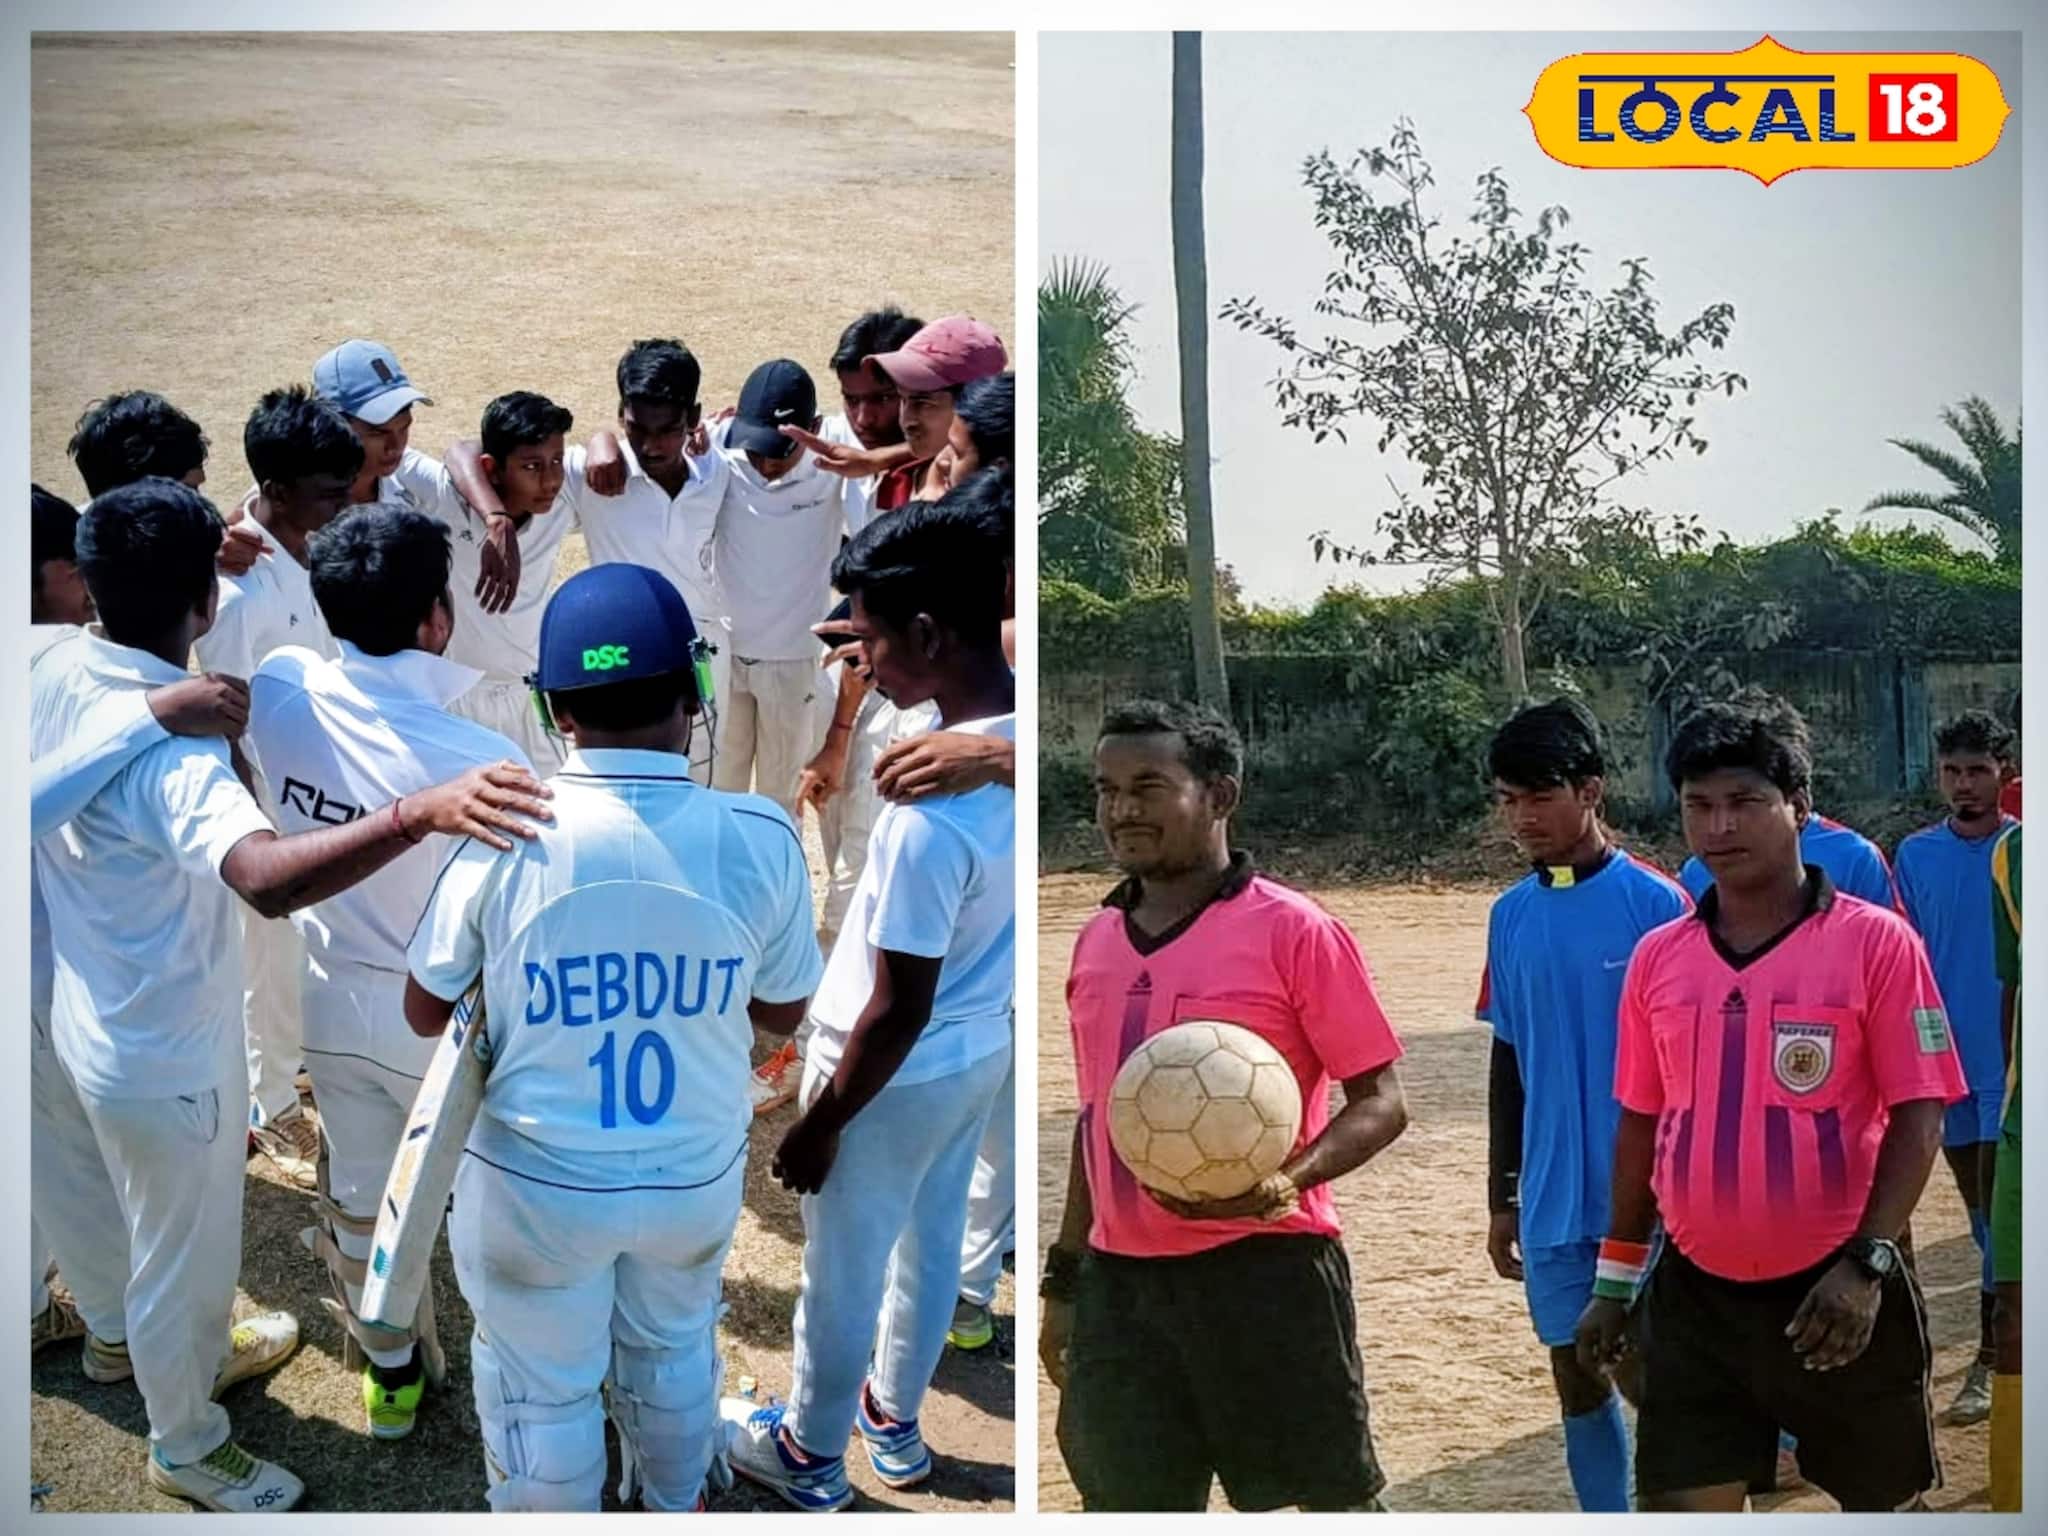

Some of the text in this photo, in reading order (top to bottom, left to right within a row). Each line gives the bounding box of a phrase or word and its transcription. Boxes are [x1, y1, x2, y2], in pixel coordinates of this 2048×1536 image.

[583, 644, 630, 671] DSC
[523, 951, 744, 1027] DEBDUT
[588, 1029, 676, 1129] 10
[253, 1487, 286, 1508] DSC
